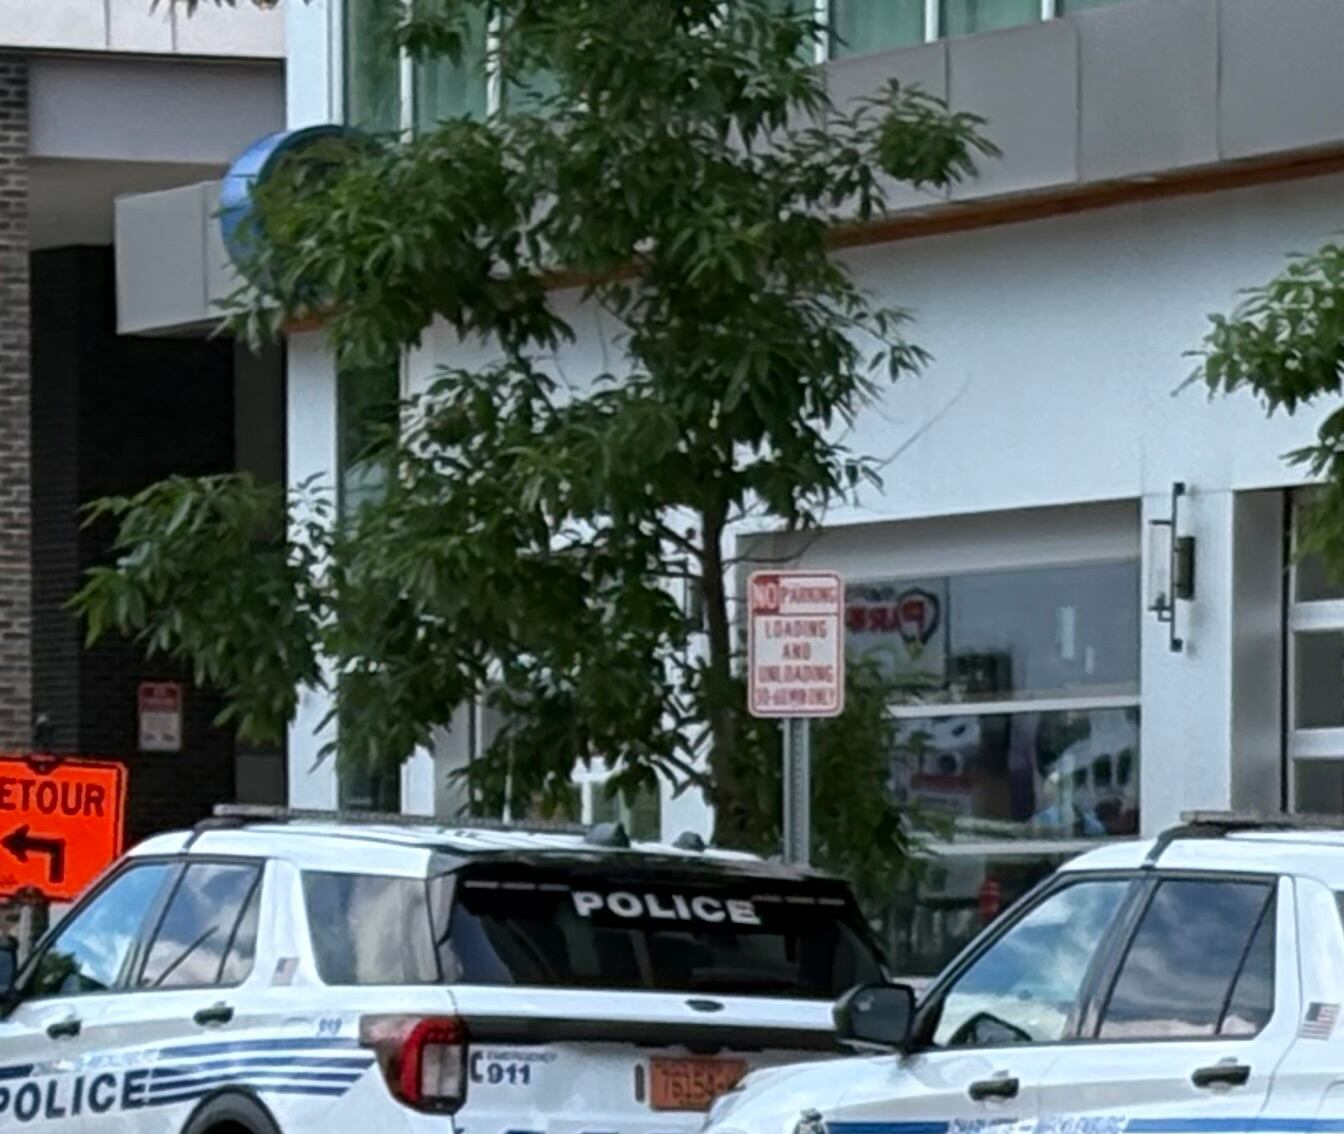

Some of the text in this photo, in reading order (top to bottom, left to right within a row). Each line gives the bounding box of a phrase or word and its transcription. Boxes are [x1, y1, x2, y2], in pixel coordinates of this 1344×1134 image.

[753, 583, 778, 611] NO
[764, 619, 827, 638] LOADING
[782, 641, 812, 661] AND
[758, 664, 834, 683] UNLOADING
[571, 890, 762, 926] POLICE
[487, 1063, 531, 1085] 911
